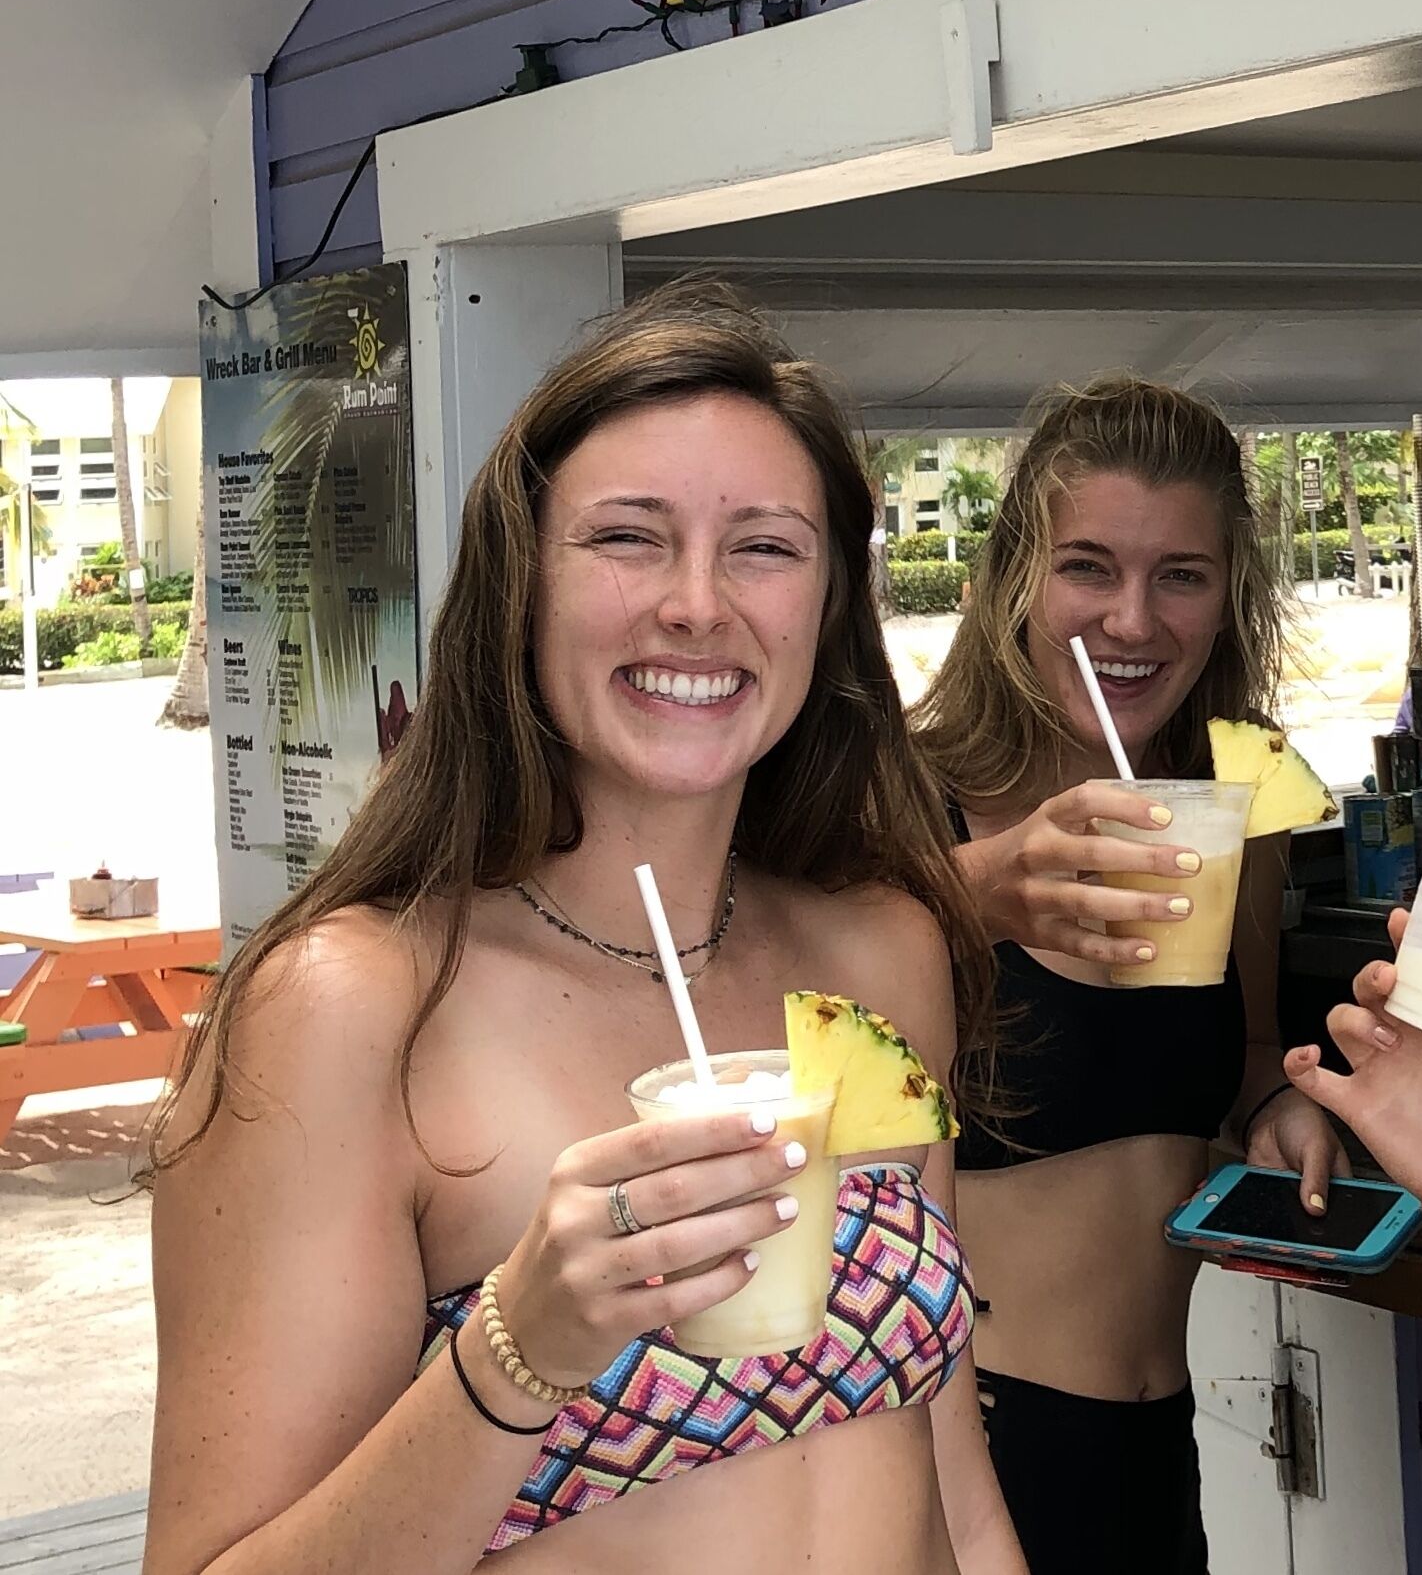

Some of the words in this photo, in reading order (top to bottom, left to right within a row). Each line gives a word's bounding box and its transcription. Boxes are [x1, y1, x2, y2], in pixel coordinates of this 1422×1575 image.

[206, 354, 239, 381] Wreck
[242, 352, 261, 375] Bar
[264, 348, 272, 371] &
[275, 344, 299, 369] Grill
[303, 342, 337, 365] Menu
[343, 385, 368, 410] Rum
[369, 380, 397, 407] Point
